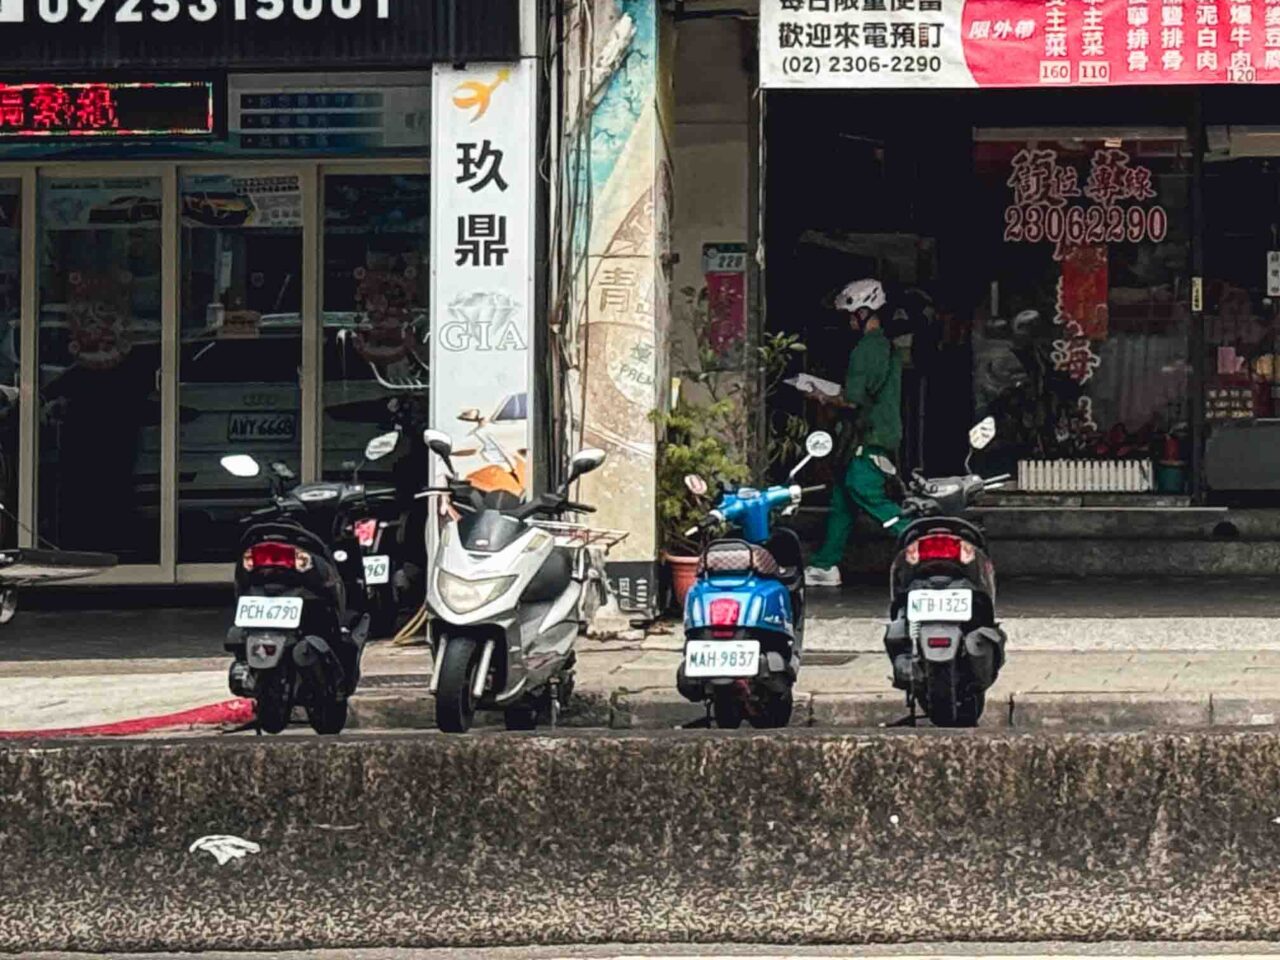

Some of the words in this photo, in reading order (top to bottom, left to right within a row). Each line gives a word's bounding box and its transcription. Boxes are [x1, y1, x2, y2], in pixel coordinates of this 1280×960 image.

[778, 22, 944, 48] 歡迎來電預訂
[782, 56, 821, 75] (02)
[829, 56, 941, 72] 2306-2290
[1042, 65, 1069, 79] 160
[1081, 65, 1107, 78] 110
[455, 139, 509, 267] 玖鼎
[1004, 206, 1168, 242] 23062290
[439, 321, 529, 352] GIA
